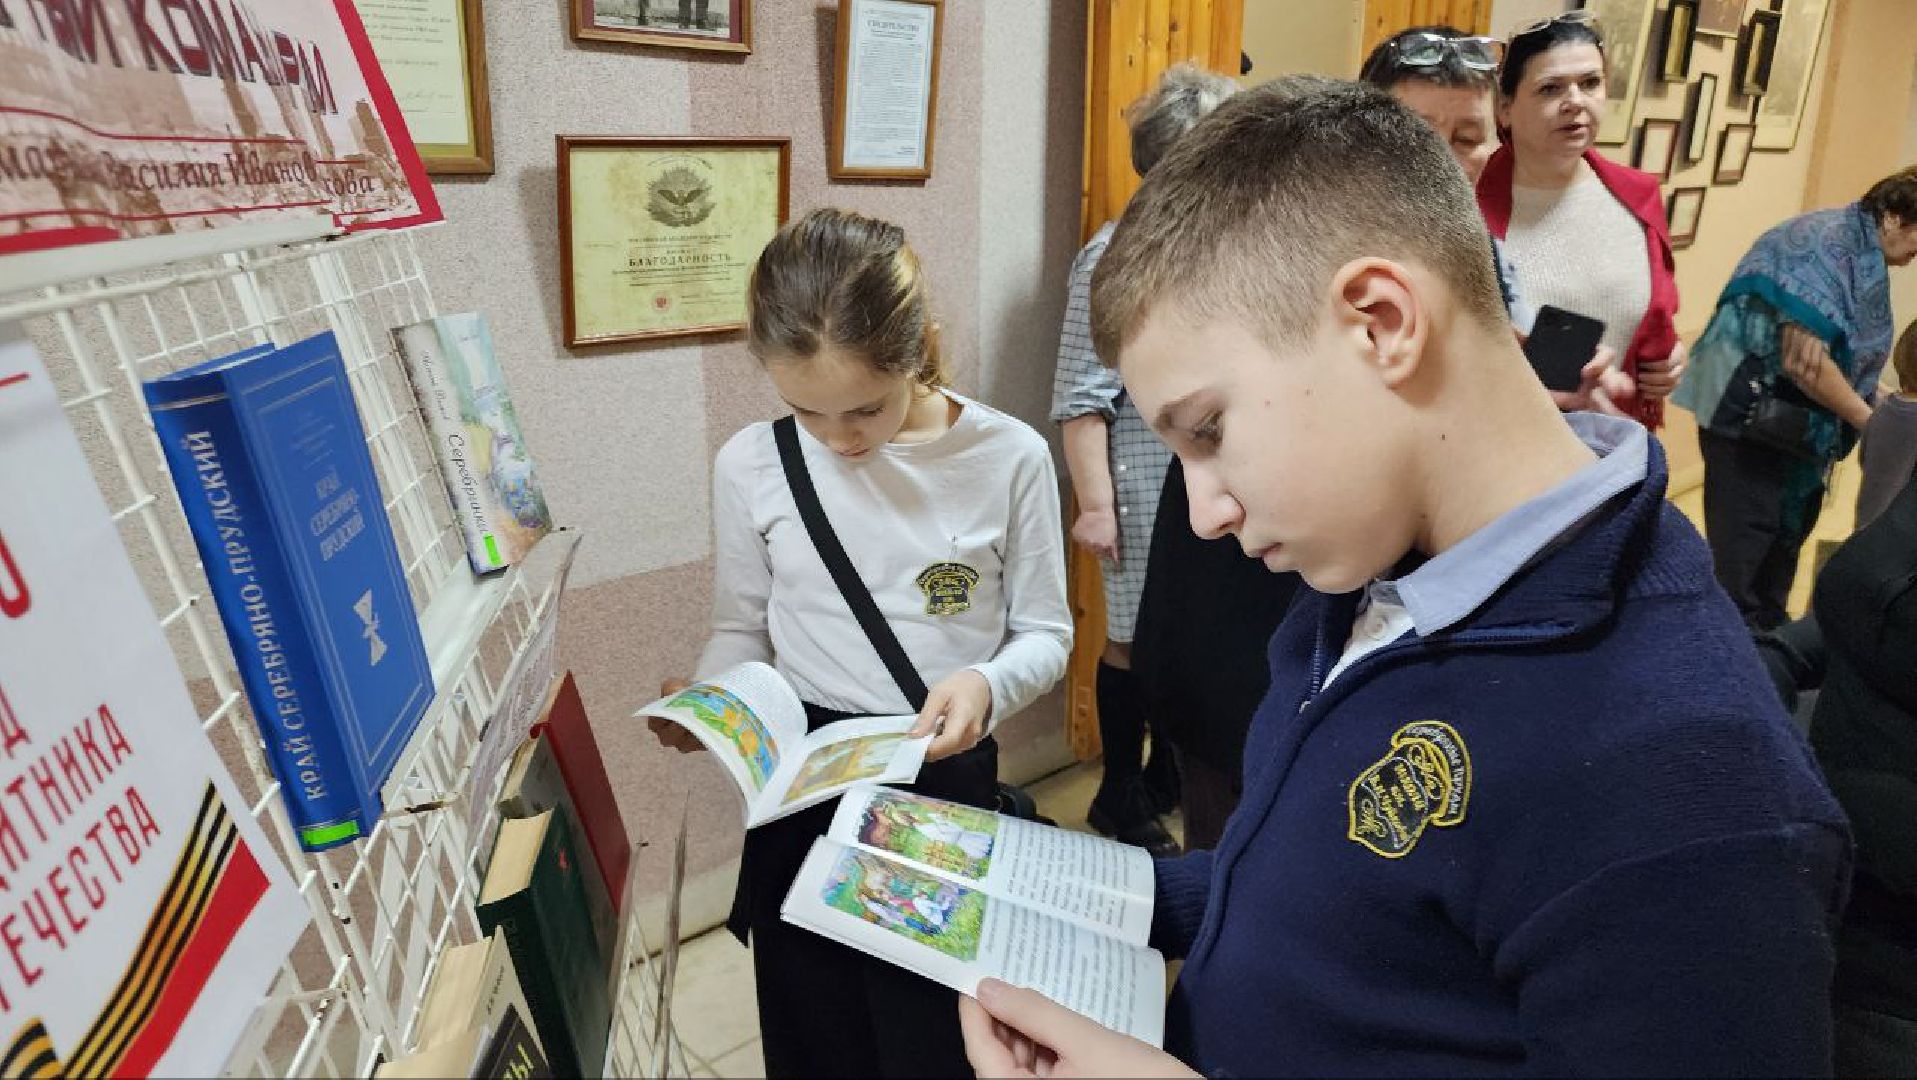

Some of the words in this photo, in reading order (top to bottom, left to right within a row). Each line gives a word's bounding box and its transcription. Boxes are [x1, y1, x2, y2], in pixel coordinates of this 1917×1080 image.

[629, 253, 731, 267] БЛАГОДАРНОСТЬ
[180, 431, 306, 732] СЕРЕБРЯНО-ПРУДСКИЙ
[0, 704, 133, 890] ИТНИКА
[284, 737, 328, 800] КРАЙ
[0, 786, 160, 1013] ЕЧЕСТВА
